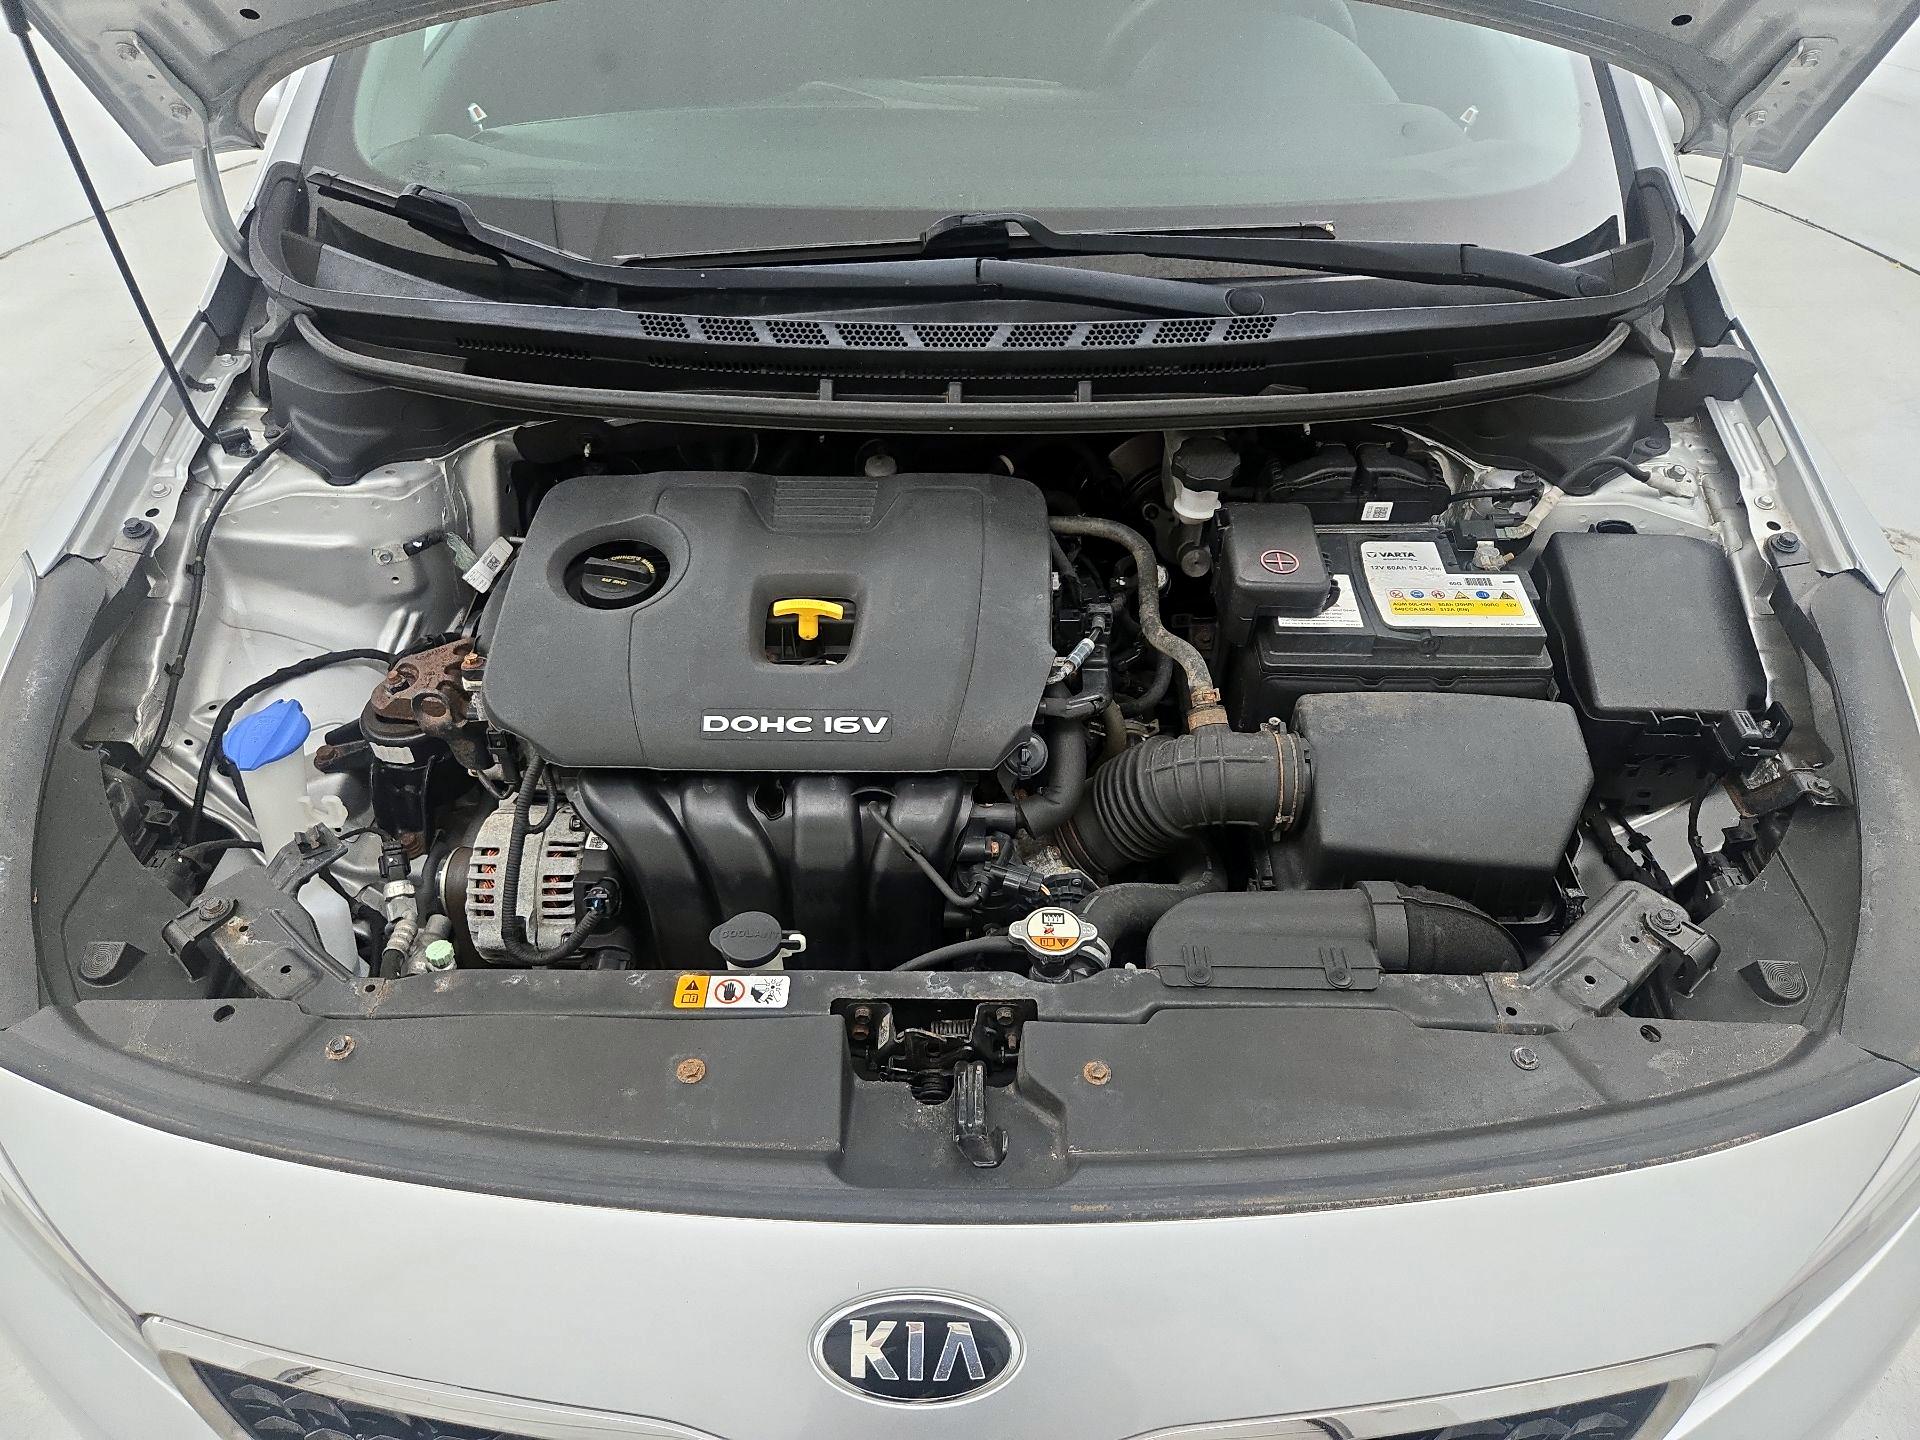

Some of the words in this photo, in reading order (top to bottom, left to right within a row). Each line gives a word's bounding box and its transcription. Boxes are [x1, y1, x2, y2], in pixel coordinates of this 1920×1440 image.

[702, 715, 813, 733] DOHC
[823, 716, 889, 734] 16V
[850, 1320, 985, 1381] KIA
